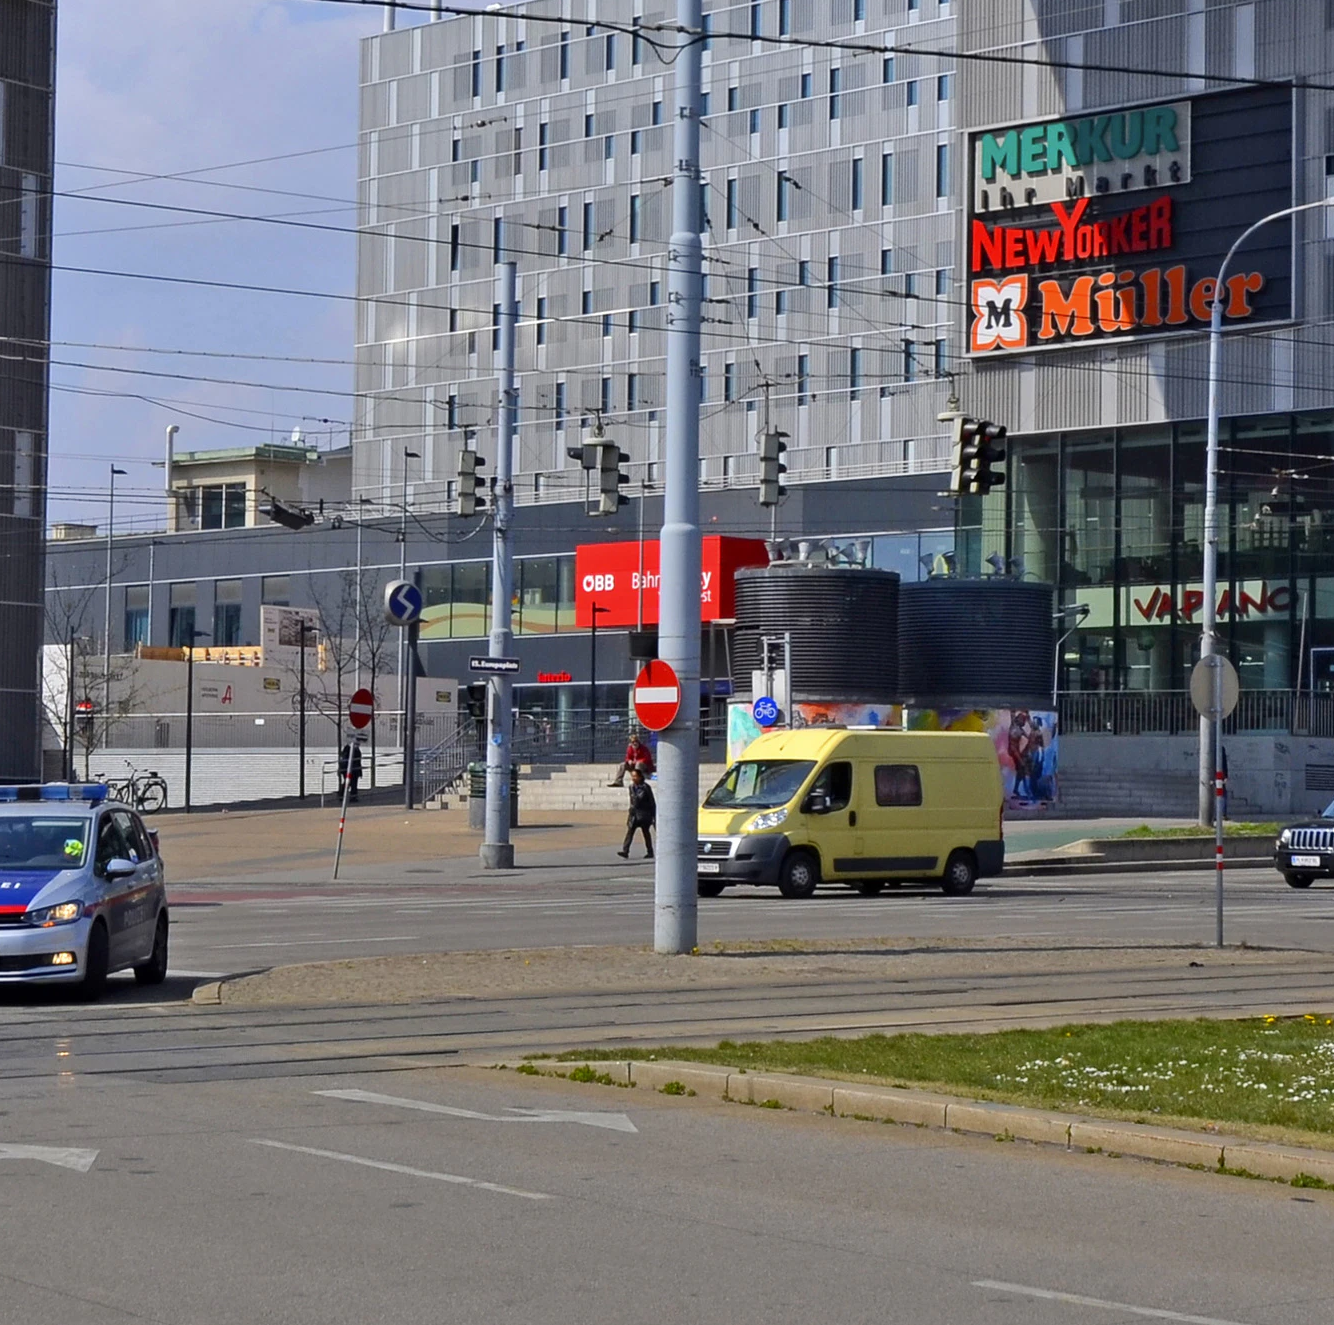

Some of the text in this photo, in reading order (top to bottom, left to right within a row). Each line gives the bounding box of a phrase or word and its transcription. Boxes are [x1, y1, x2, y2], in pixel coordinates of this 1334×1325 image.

[981, 107, 1180, 181] MERKUR
[981, 160, 1182, 210] Ihr Markt
[1038, 264, 1264, 340] Müller
[582, 574, 615, 592] ÖBB
[1133, 580, 1299, 623] VAPANO
